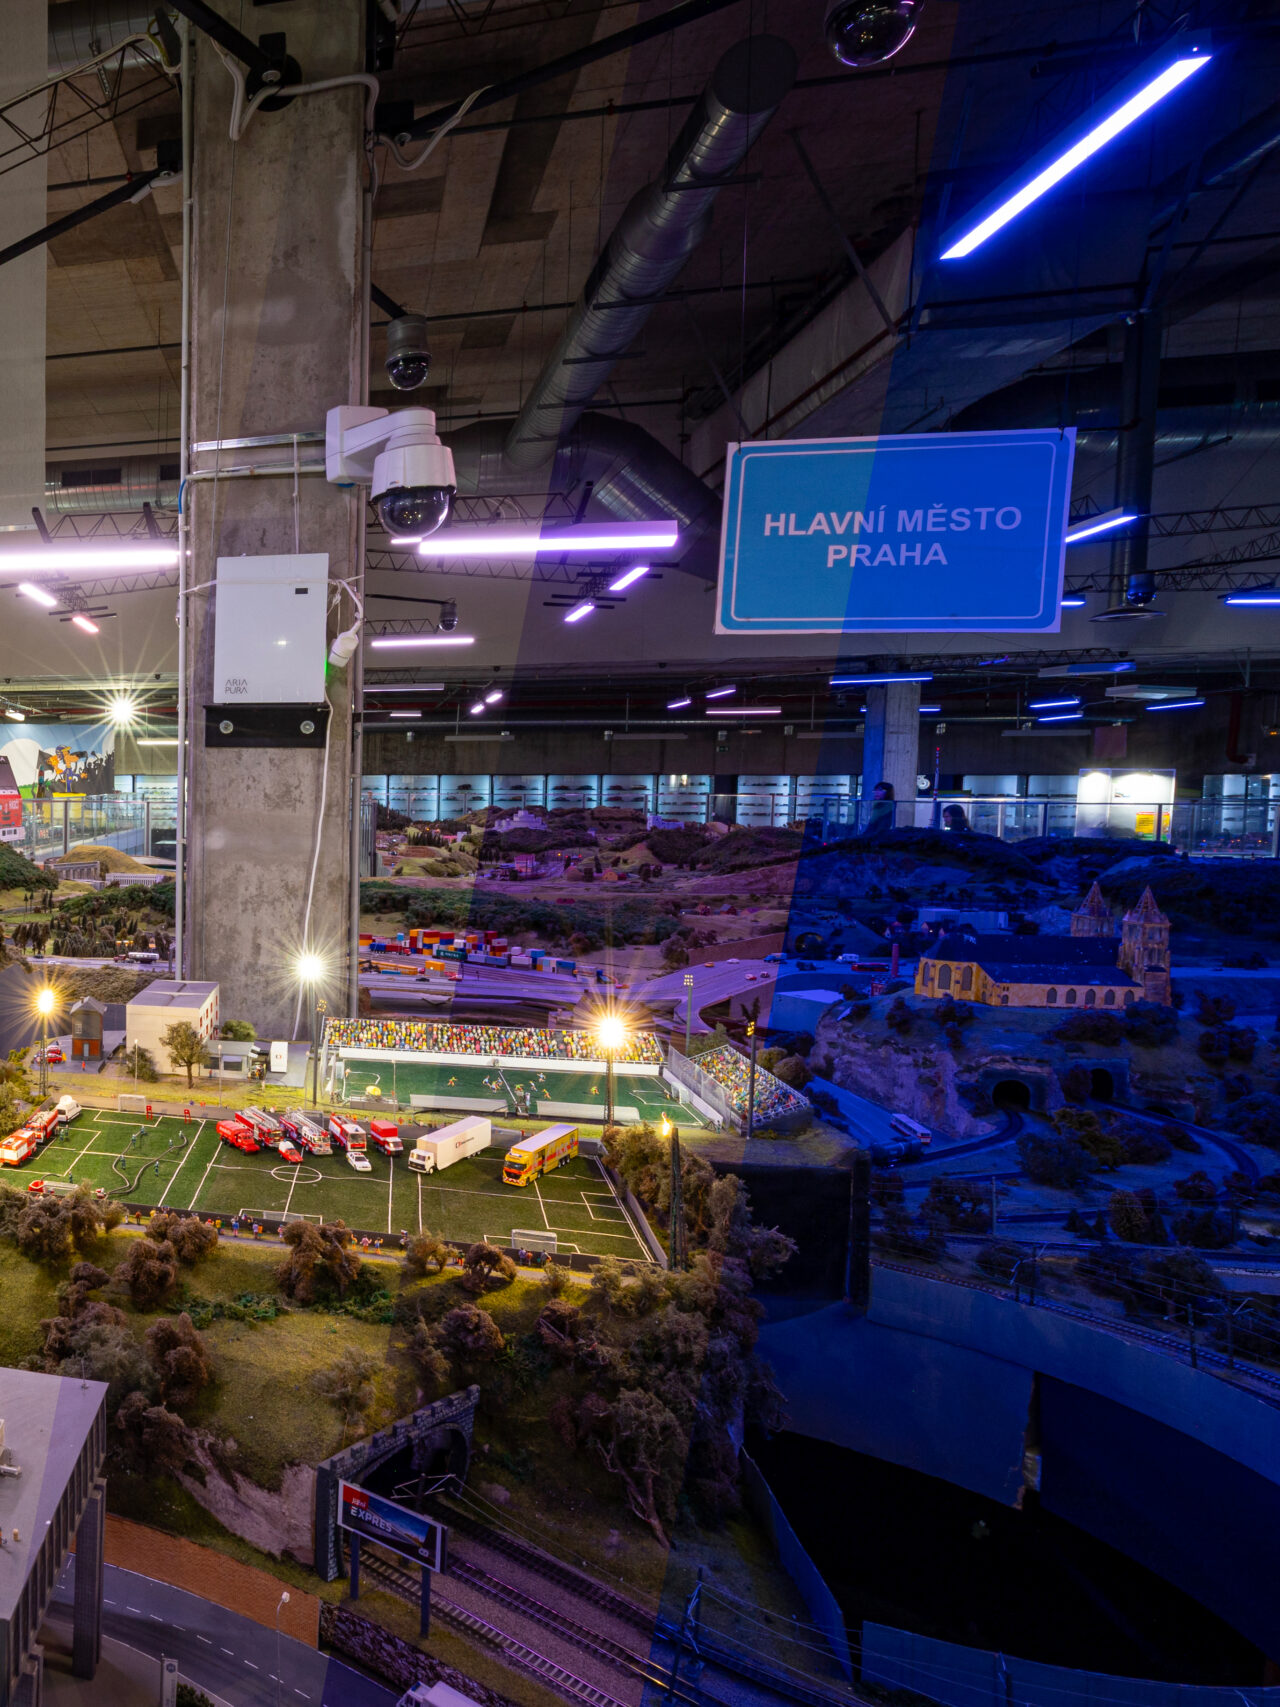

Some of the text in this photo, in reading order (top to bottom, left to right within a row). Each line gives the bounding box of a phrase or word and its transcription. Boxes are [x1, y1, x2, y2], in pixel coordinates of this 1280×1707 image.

[764, 503, 1022, 536] HLAVNÍ MĚSTO
[826, 542, 948, 568] PRAHA
[350, 1506, 392, 1532] EXPRES
